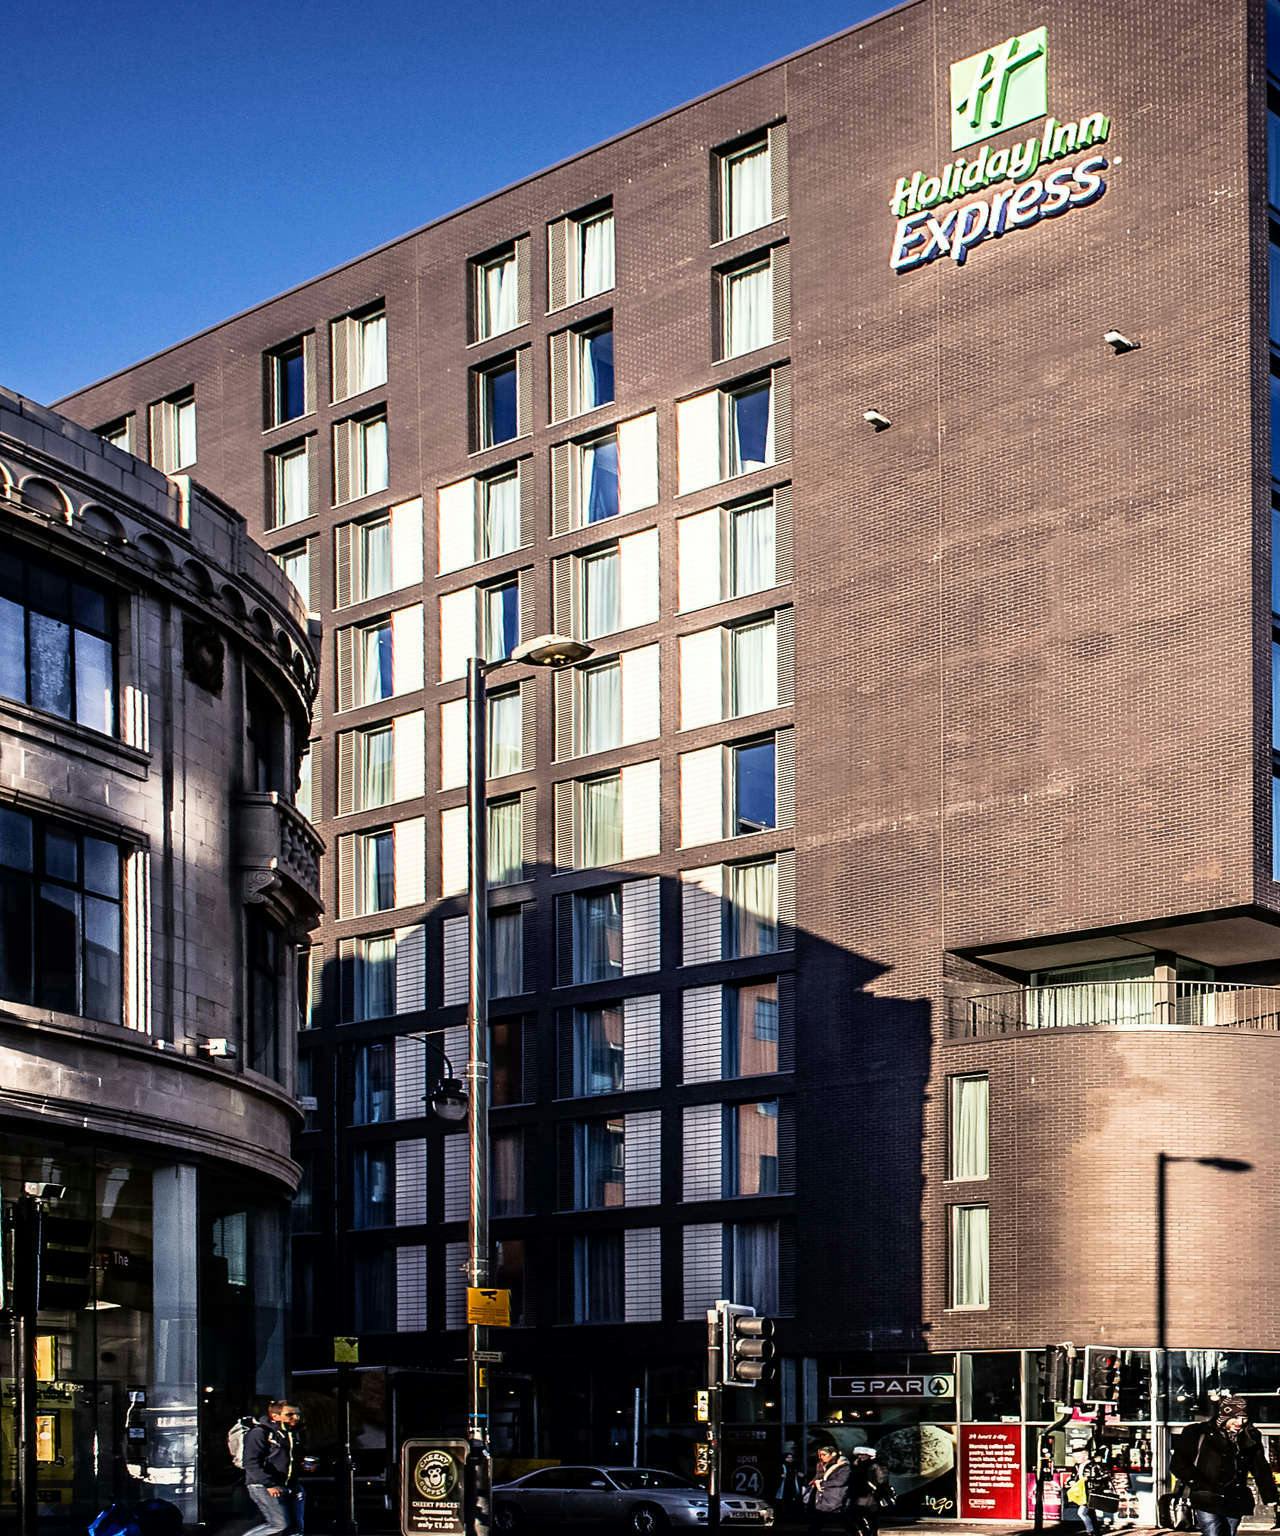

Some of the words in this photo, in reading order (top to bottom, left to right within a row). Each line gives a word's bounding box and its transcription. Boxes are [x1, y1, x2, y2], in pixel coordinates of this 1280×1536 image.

[890, 138, 1041, 217] Holiday
[1040, 112, 1110, 163] Inn
[891, 156, 1109, 274] Express
[850, 1381, 922, 1393] SPAR
[420, 1454, 449, 1468] CHEEKY
[735, 1472, 759, 1492] 24
